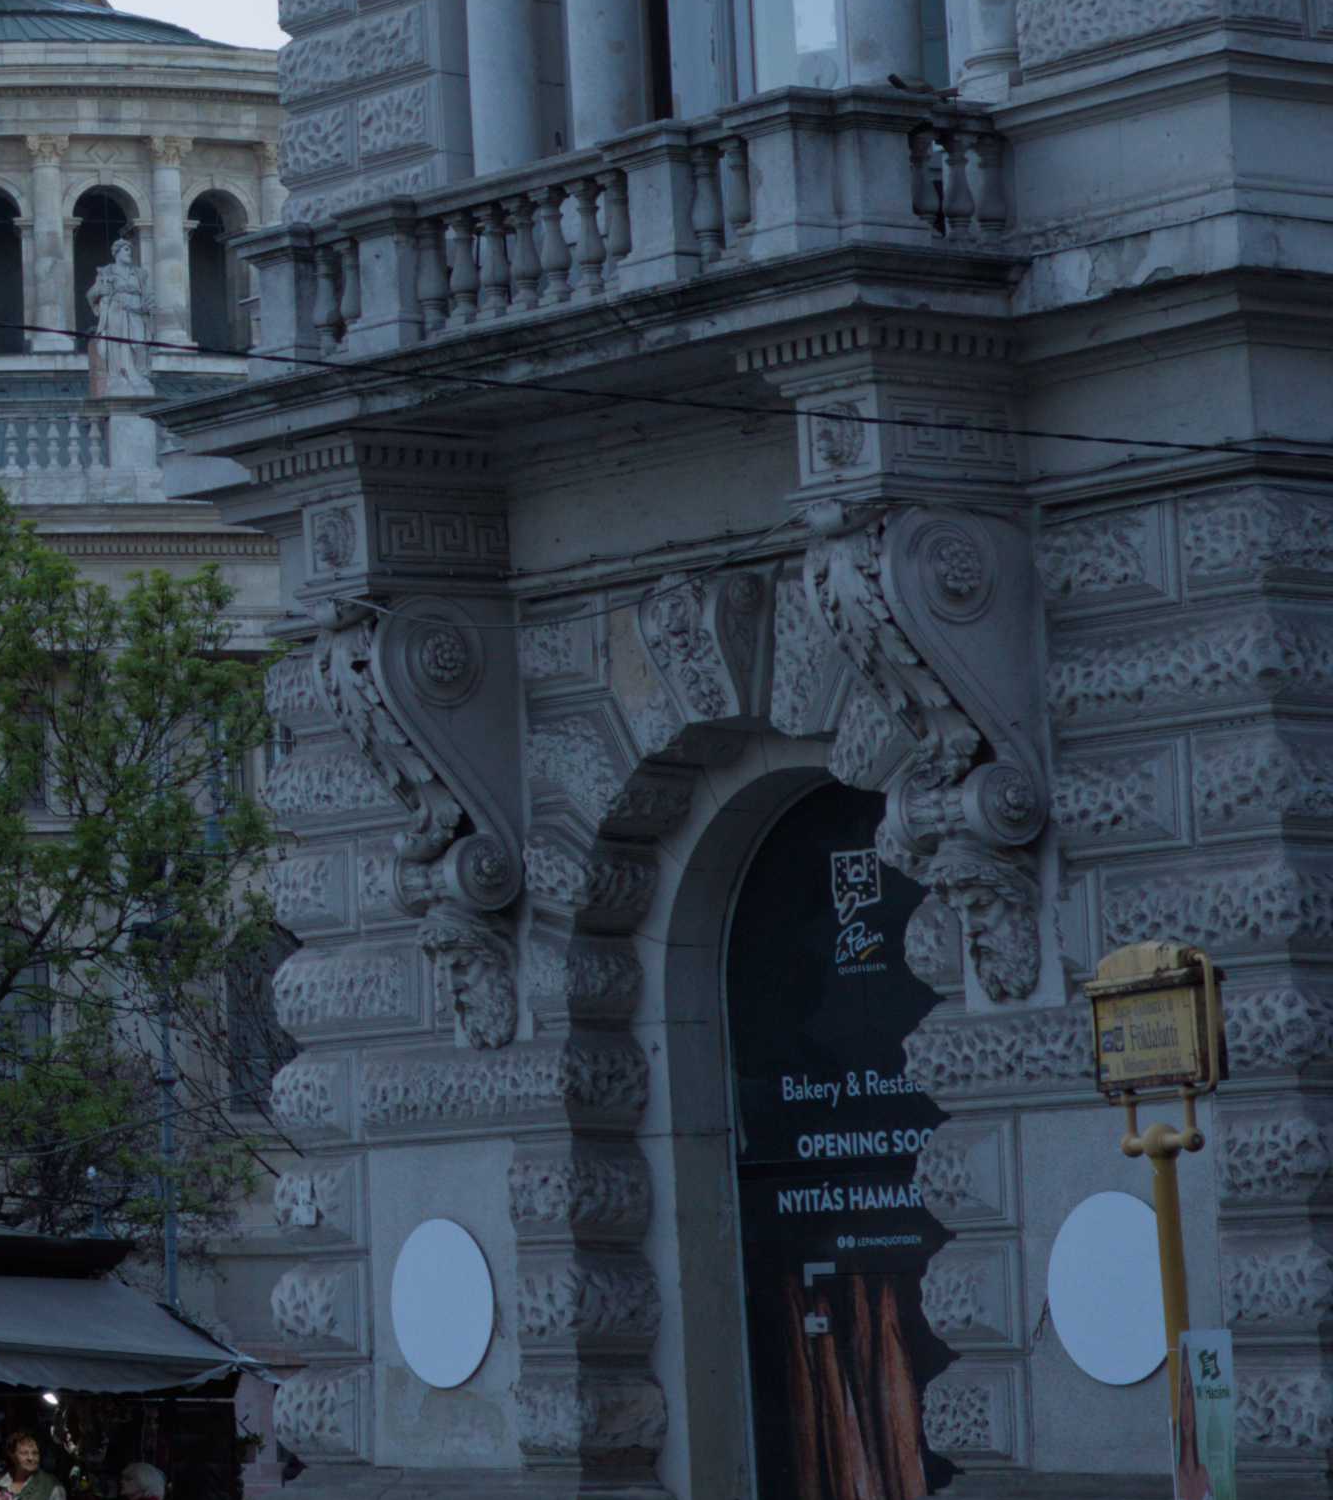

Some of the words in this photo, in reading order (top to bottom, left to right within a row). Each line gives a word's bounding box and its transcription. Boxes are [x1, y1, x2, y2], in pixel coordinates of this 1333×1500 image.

[782, 1074, 841, 1109] Bakery
[846, 1071, 861, 1097] &
[797, 1131, 888, 1159] OPENING
[892, 1128, 933, 1154] SOO
[776, 1180, 845, 1215] NYITÁS
[848, 1184, 923, 1211] HAMAR
